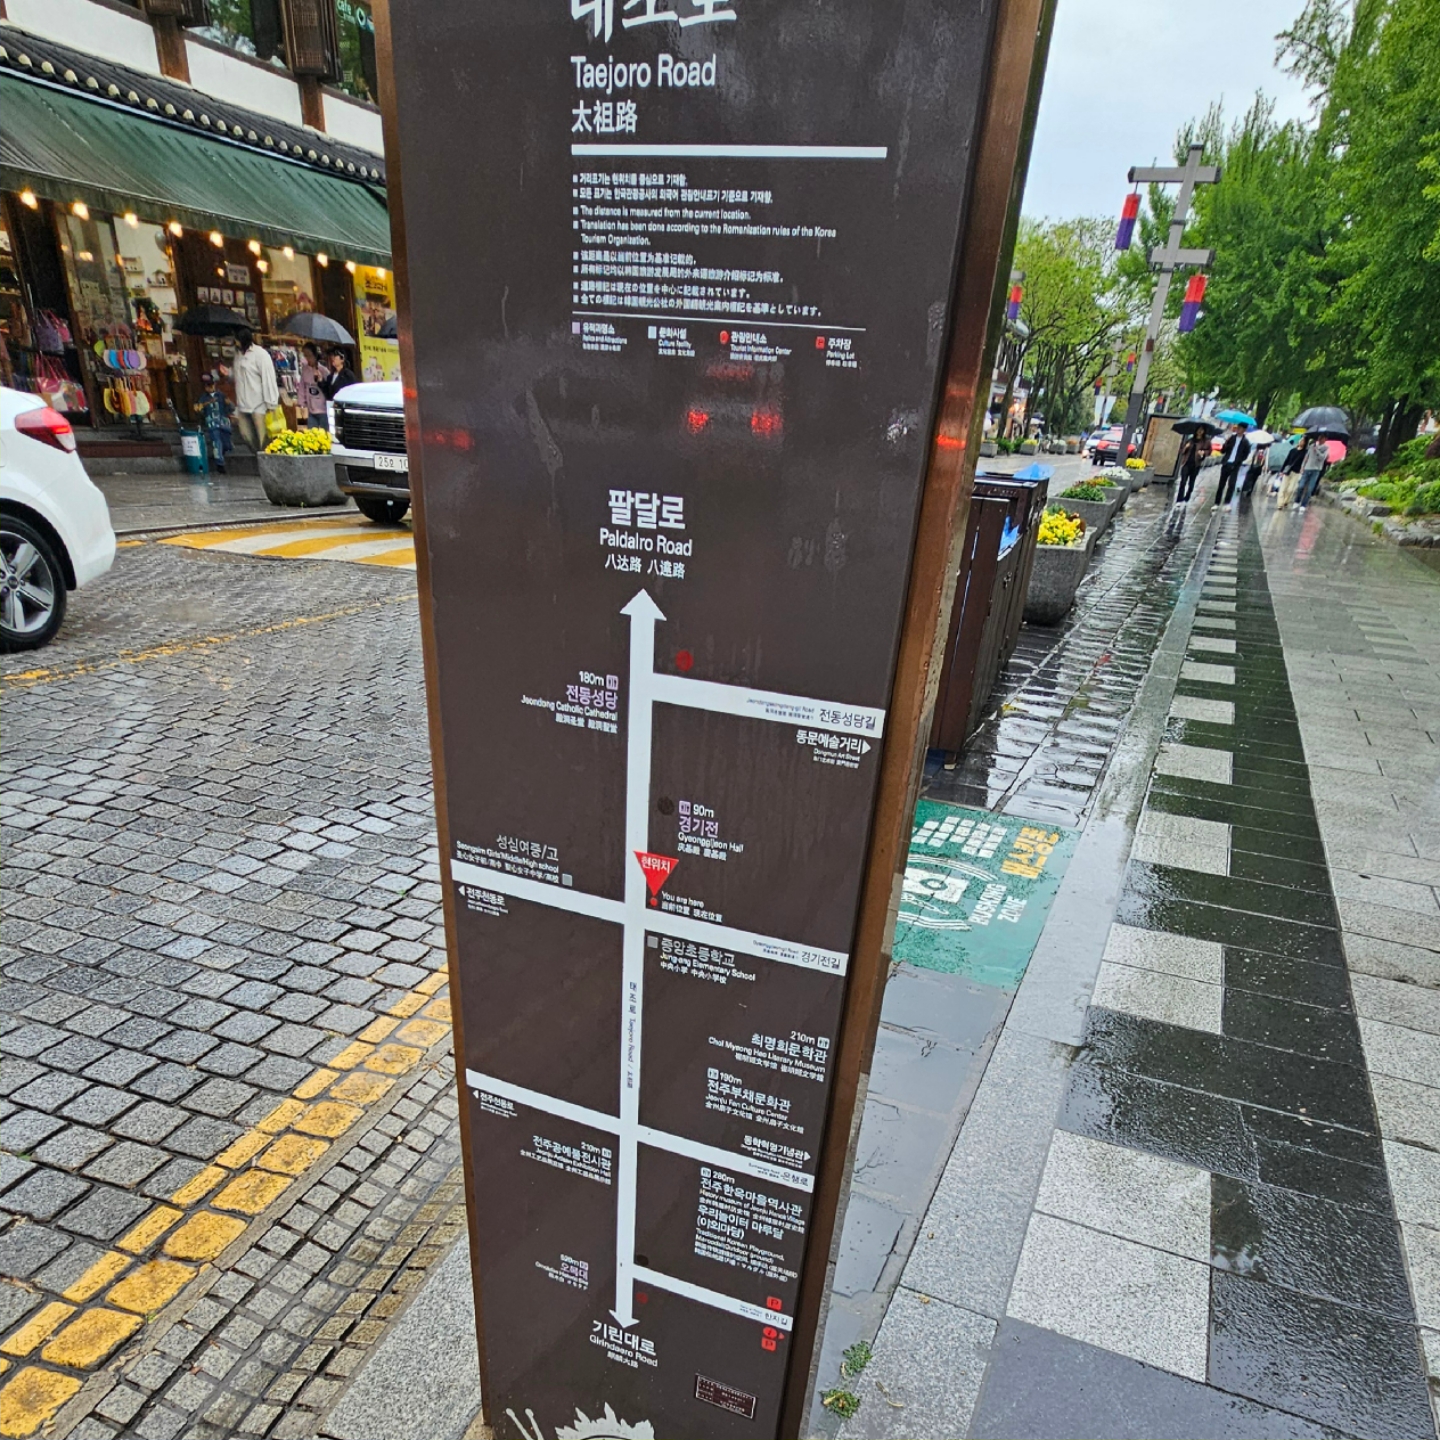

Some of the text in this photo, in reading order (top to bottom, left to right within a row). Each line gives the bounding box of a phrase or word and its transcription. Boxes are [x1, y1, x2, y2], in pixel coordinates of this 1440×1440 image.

[571, 53, 717, 95] Taejoro Road
[571, 99, 638, 134] 太祖路
[581, 205, 593, 216] The
[594, 205, 621, 217] distance
[629, 207, 663, 218] measured
[664, 207, 680, 218] from
[682, 208, 693, 218] the
[694, 209, 720, 219] current
[720, 209, 751, 220] location.
[581, 219, 837, 238] Translation has been done according to the Romanization rules of the Korea
[581, 233, 606, 244] Tourism
[828, 337, 852, 351] 주차장
[608, 489, 686, 530] 팔달로
[656, 534, 693, 557] Road
[605, 553, 642, 573] 八达路
[579, 671, 605, 686] 180m
[521, 695, 618, 721] Jeondong Catholic Cathedral
[566, 684, 618, 710] 전동성당
[819, 708, 876, 731] 전동성당길
[796, 729, 862, 754] 동문예술거리
[693, 804, 714, 818] 90m
[679, 816, 718, 838] 경기전
[497, 835, 559, 861] 성심여중/고
[729, 842, 744, 853] Hall
[641, 856, 671, 874] 현위치
[661, 891, 705, 908] You are here
[997, 895, 1027, 923] ZONE
[661, 937, 735, 967] 중앙초등학교
[802, 950, 841, 970] 경기전길
[692, 959, 731, 977] Elementary
[731, 968, 756, 982] School
[751, 1033, 828, 1063] 최명희문학관
[790, 1031, 815, 1045] 210m
[794, 1058, 826, 1073] Museum
[720, 1072, 743, 1085] 190m
[707, 1079, 792, 1113] 전주부채문화관
[741, 1102, 765, 1115] Culture
[766, 1109, 788, 1121] Center
[532, 1135, 612, 1171] 전주공예품전시관
[712, 1170, 735, 1184] 280m
[700, 1178, 802, 1217] 전주한옥마을역사관
[698, 1204, 784, 1240] 우리놀이터 마루달
[561, 1262, 588, 1280] 오목대
[592, 1320, 656, 1355] 기린대로
[635, 1351, 658, 1367] Road
